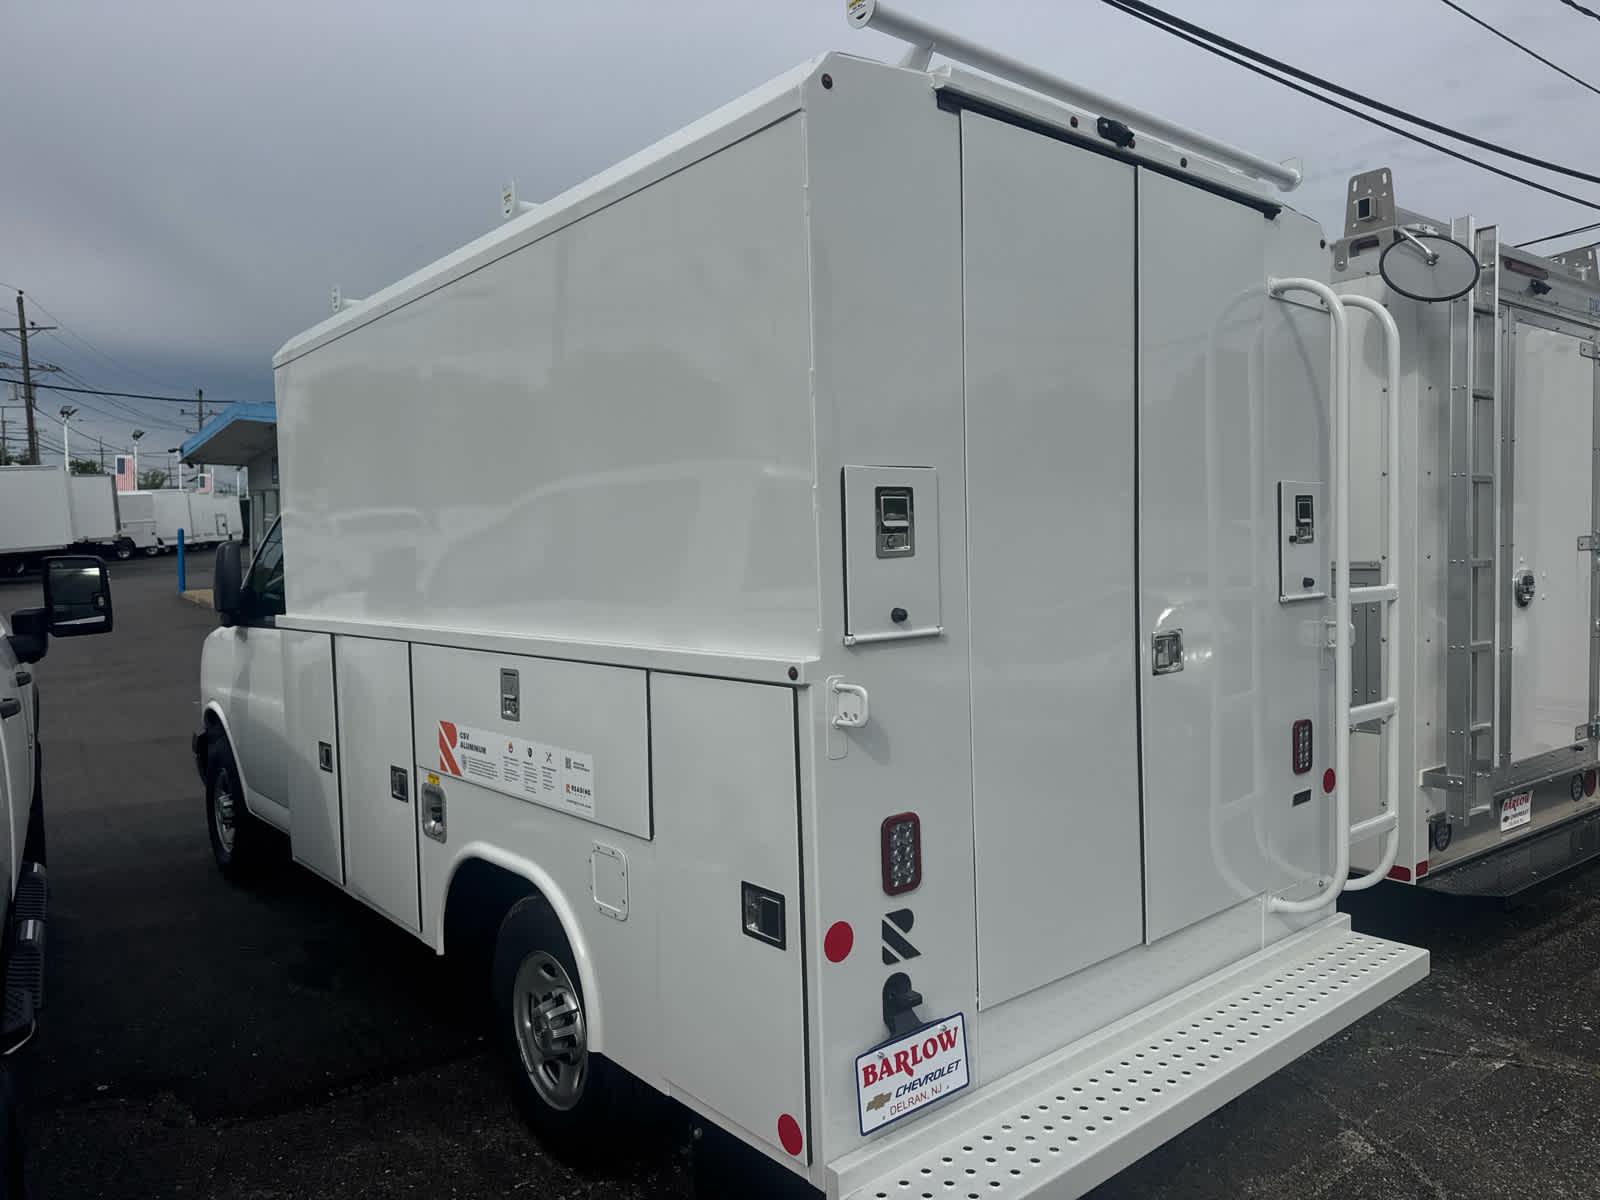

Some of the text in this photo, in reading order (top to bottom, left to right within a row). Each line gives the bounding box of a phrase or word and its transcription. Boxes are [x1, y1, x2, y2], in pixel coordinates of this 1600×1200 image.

[460, 741, 487, 754] ALUMINUM
[571, 784, 591, 796] READING
[862, 1026, 959, 1088] BARLOW
[895, 1059, 962, 1098] CHEVROLET
[931, 1084, 942, 1097] NJ
